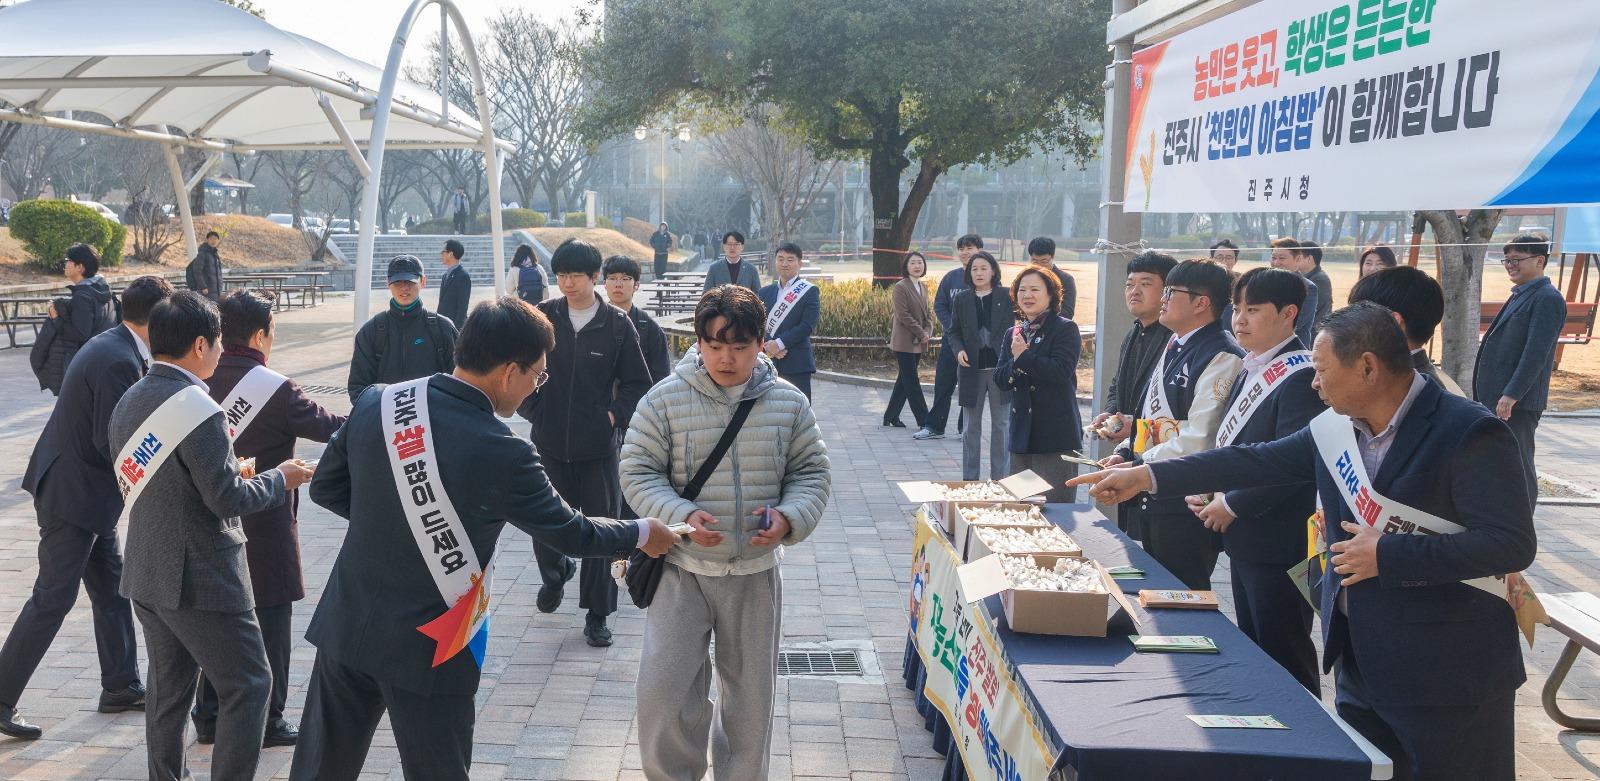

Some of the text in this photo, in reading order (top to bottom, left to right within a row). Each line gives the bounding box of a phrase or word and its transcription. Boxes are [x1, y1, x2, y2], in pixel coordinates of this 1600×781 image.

[1193, 42, 1239, 102] 농민은
[1240, 28, 1280, 91] 웃고,
[1284, 5, 1351, 77] 학생은
[1352, 0, 1437, 62] 든든한
[1162, 115, 1203, 166] 진주시
[1349, 50, 1500, 144] 함께합니다
[773, 302, 788, 319] 많이
[1238, 382, 1263, 417] 많이
[403, 459, 437, 507] 많이
[420, 509, 469, 576] 드세요
